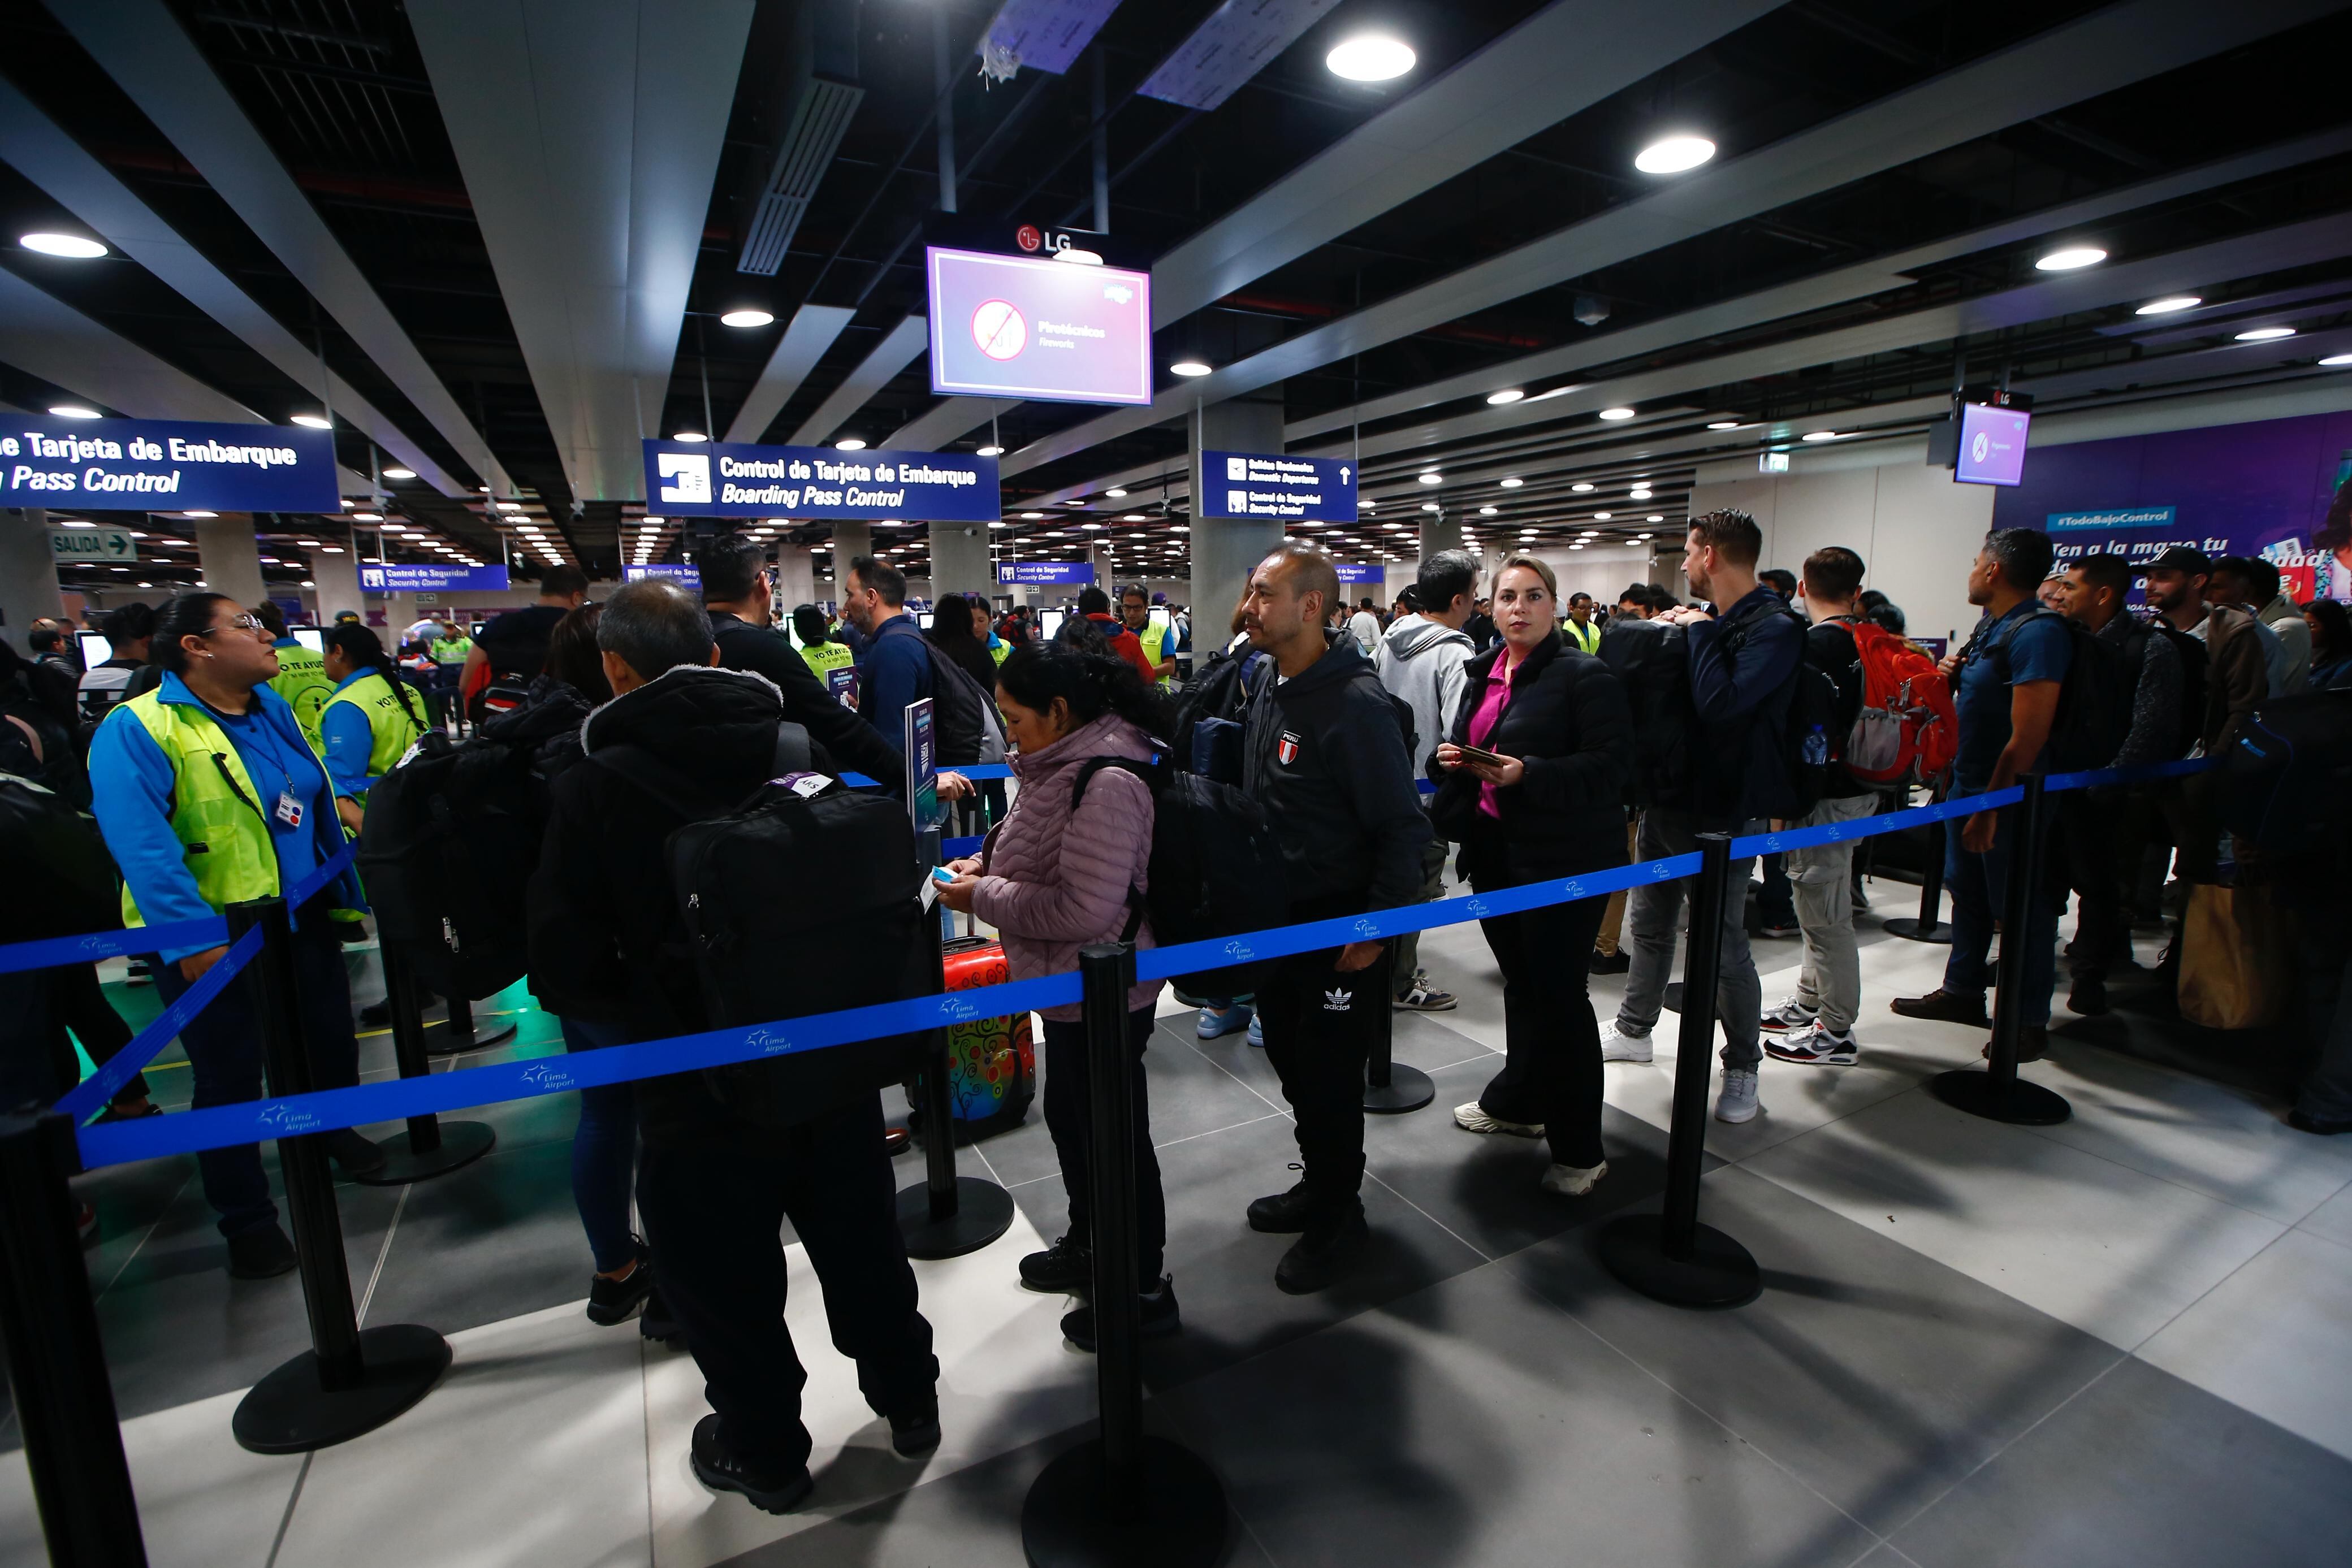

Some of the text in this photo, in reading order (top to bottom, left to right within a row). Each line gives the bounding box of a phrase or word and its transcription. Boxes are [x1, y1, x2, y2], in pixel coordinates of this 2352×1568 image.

[1045, 232, 1071, 252] LG
[1040, 337, 1074, 349] Fireworks
[0, 432, 297, 469] e Tarjeta de Embarque
[720, 456, 976, 488] Control de Tarjeta de Embarque
[12, 466, 77, 491] Pass
[84, 467, 180, 492] Control
[721, 483, 905, 509] Boarding Pass Control
[2058, 510, 2169, 526] #TodoBajoControl
[54, 536, 102, 553] SALIDA
[2106, 540, 2128, 555] la
[2203, 536, 2228, 552] tu
[430, 569, 469, 578] Seguridad
[387, 579, 419, 588] Security
[1094, 579, 1100, 587] 4
[303, 660, 325, 669] AYUD
[1283, 733, 1298, 743] PERU
[956, 1010, 979, 1019] Airport
[764, 1043, 791, 1052] Airport
[544, 1073, 567, 1082] Lima
[544, 1078, 574, 1089] Airport
[285, 1114, 312, 1123] Lima
[285, 1120, 321, 1131] Airport
